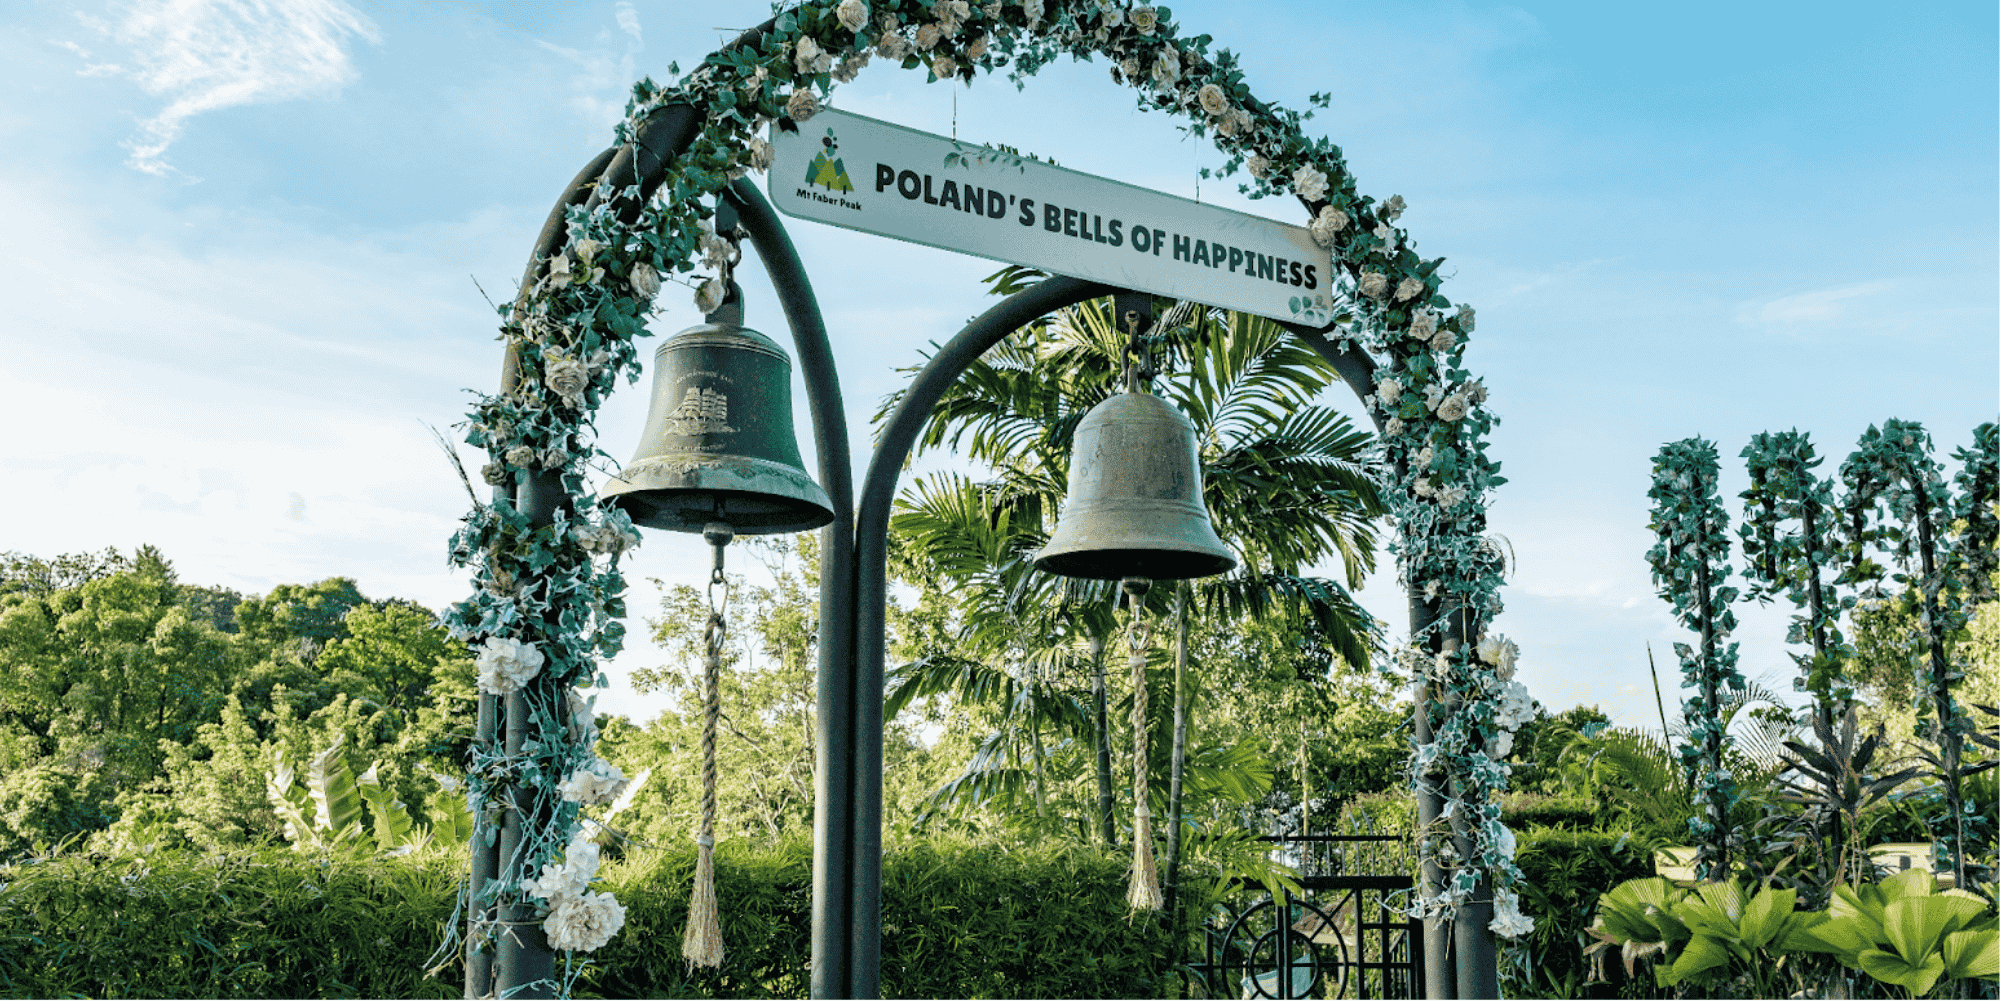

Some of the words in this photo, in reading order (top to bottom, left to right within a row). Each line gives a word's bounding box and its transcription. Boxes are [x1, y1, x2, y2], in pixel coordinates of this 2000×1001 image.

[797, 188, 810, 199] Mt
[812, 192, 838, 205] Faber
[840, 198, 862, 211] Peak
[876, 162, 1036, 227] POLAND'S
[1044, 203, 1123, 247] BELLS
[1131, 225, 1166, 256] OF
[1173, 233, 1318, 290] HAPPINESS
